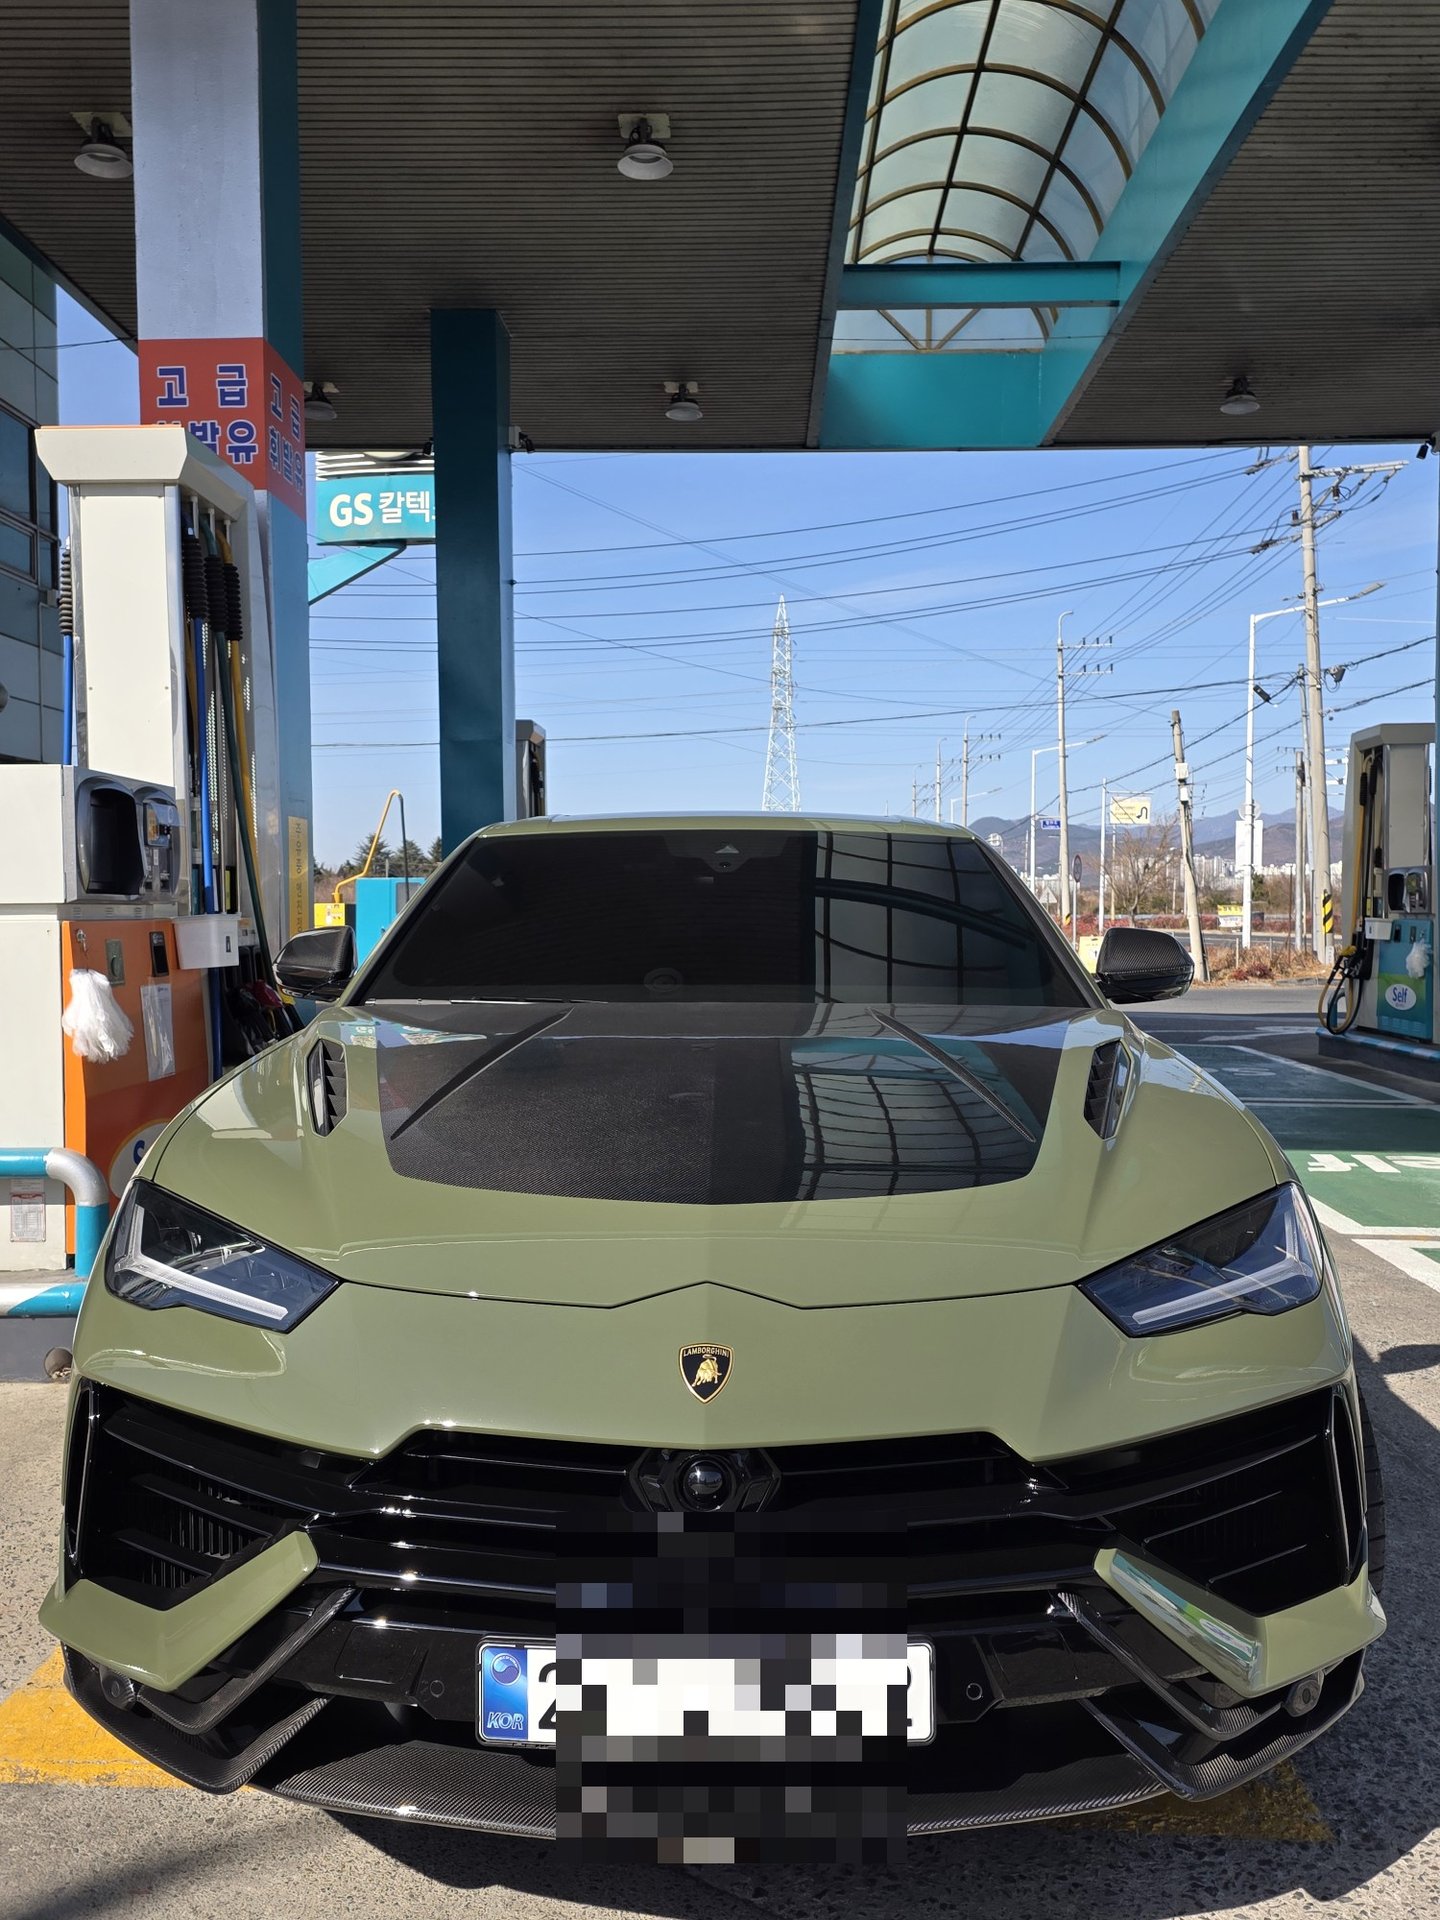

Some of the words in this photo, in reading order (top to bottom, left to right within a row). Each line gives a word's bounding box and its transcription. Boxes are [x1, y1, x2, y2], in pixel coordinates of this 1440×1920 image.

[329, 492, 374, 528] GS
[379, 490, 436, 524] 칼텍
[1392, 986, 1409, 1004] Self
[683, 1346, 730, 1358] LAMBORGHINI
[486, 1711, 524, 1731] KOR
